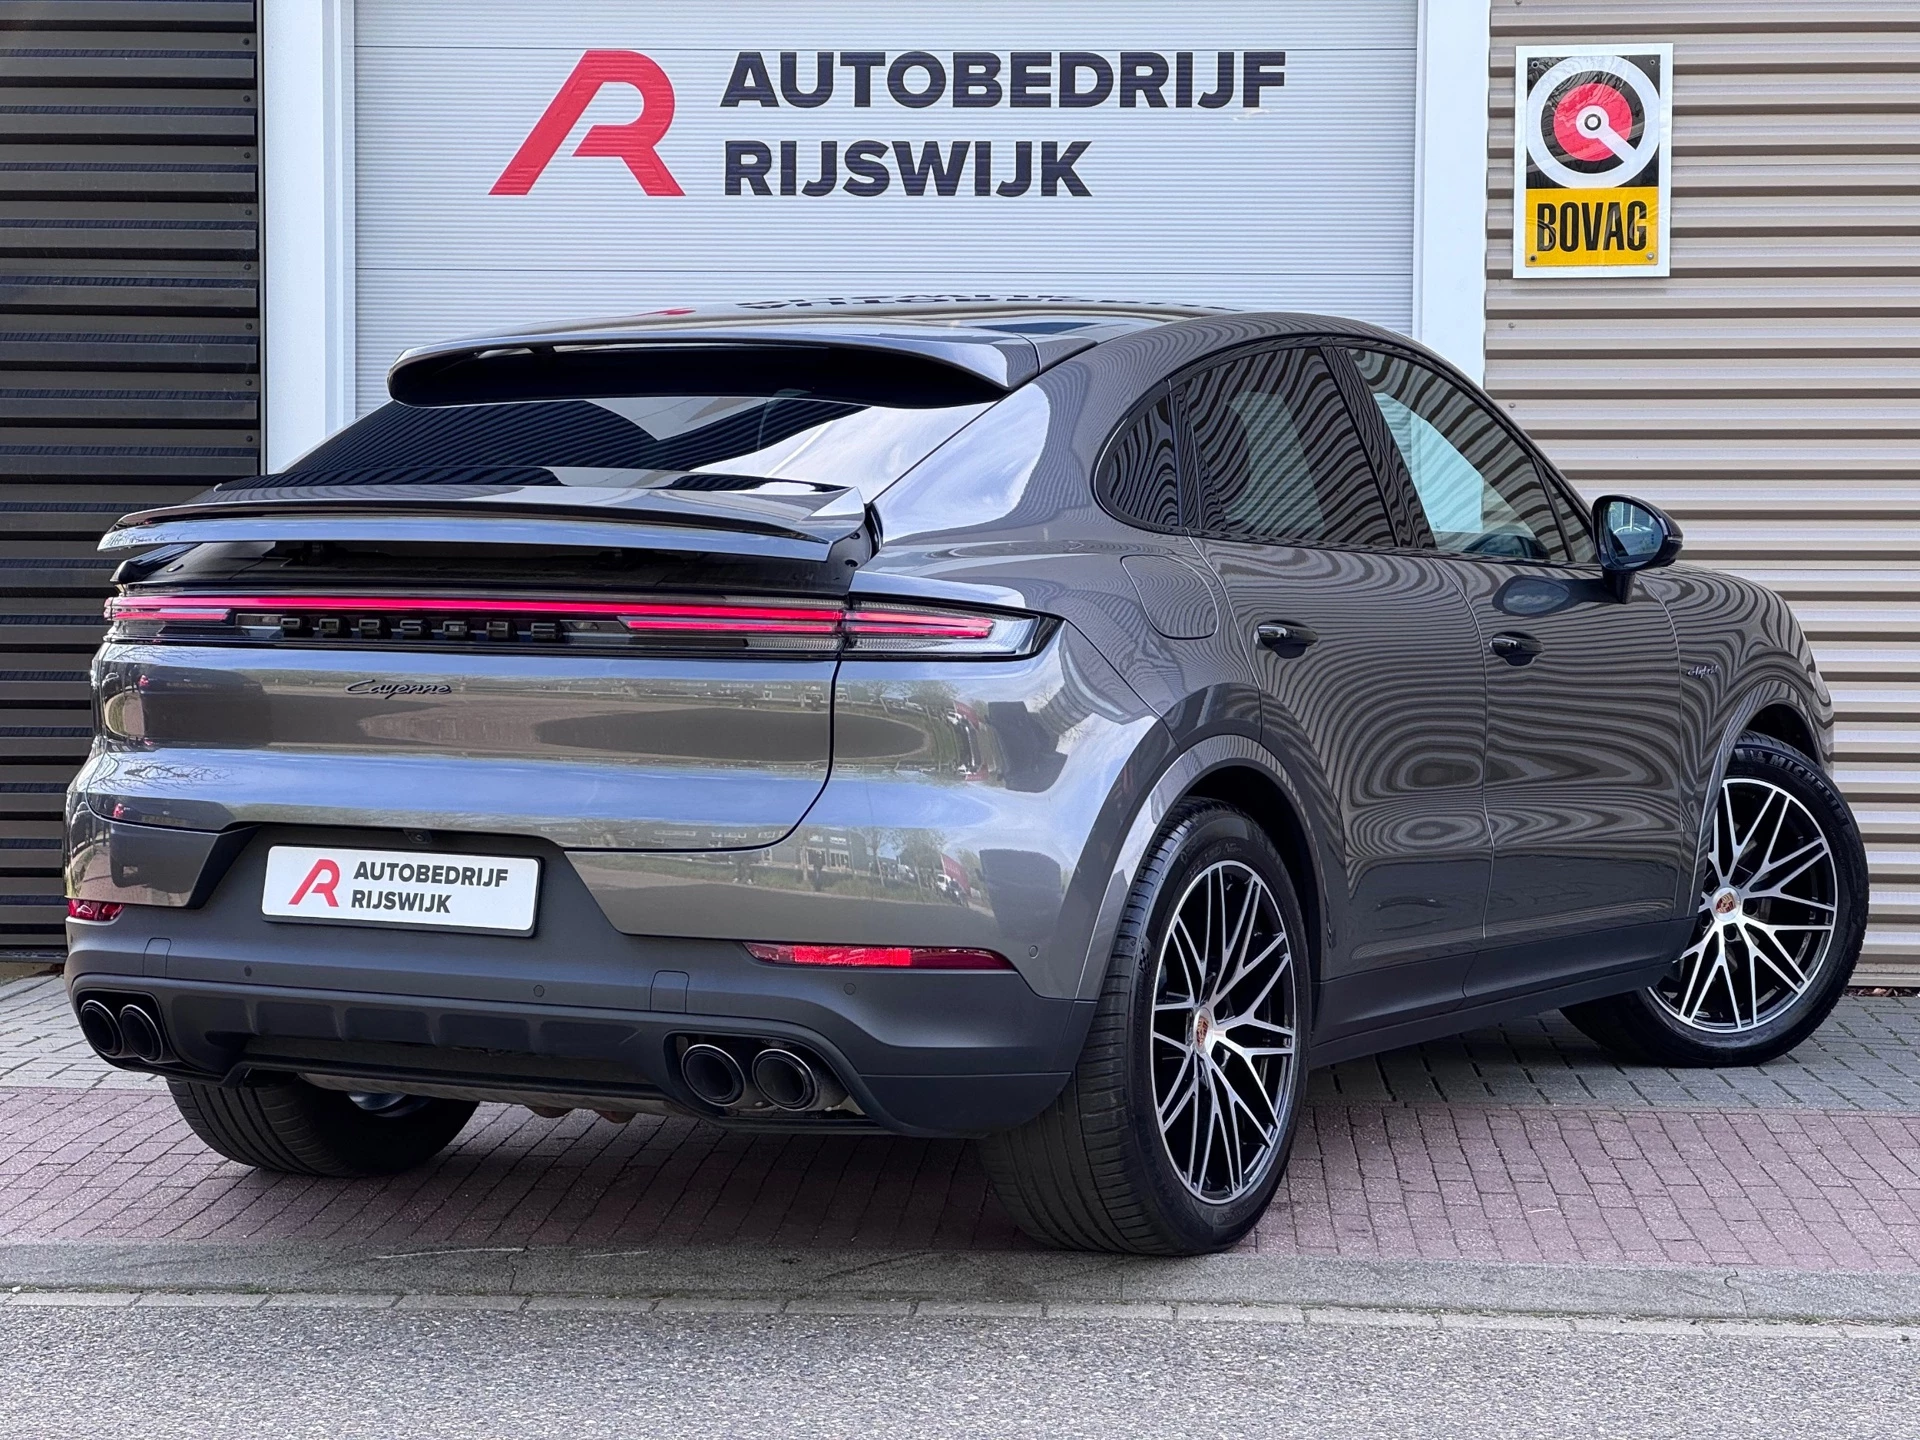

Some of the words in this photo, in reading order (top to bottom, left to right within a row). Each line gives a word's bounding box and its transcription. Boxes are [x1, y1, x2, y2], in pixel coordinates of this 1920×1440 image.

[721, 51, 1286, 108] AUTOBEDRIJF
[725, 140, 1092, 198] RIJSWIJK
[1536, 200, 1647, 252] BOVAG
[280, 617, 562, 641] PORSCHE
[344, 679, 453, 700] Cayenne
[1769, 754, 1850, 827] MICHELIN
[353, 861, 509, 888] AUTOBEDRIJF
[351, 889, 452, 913] RIJSWIJK
